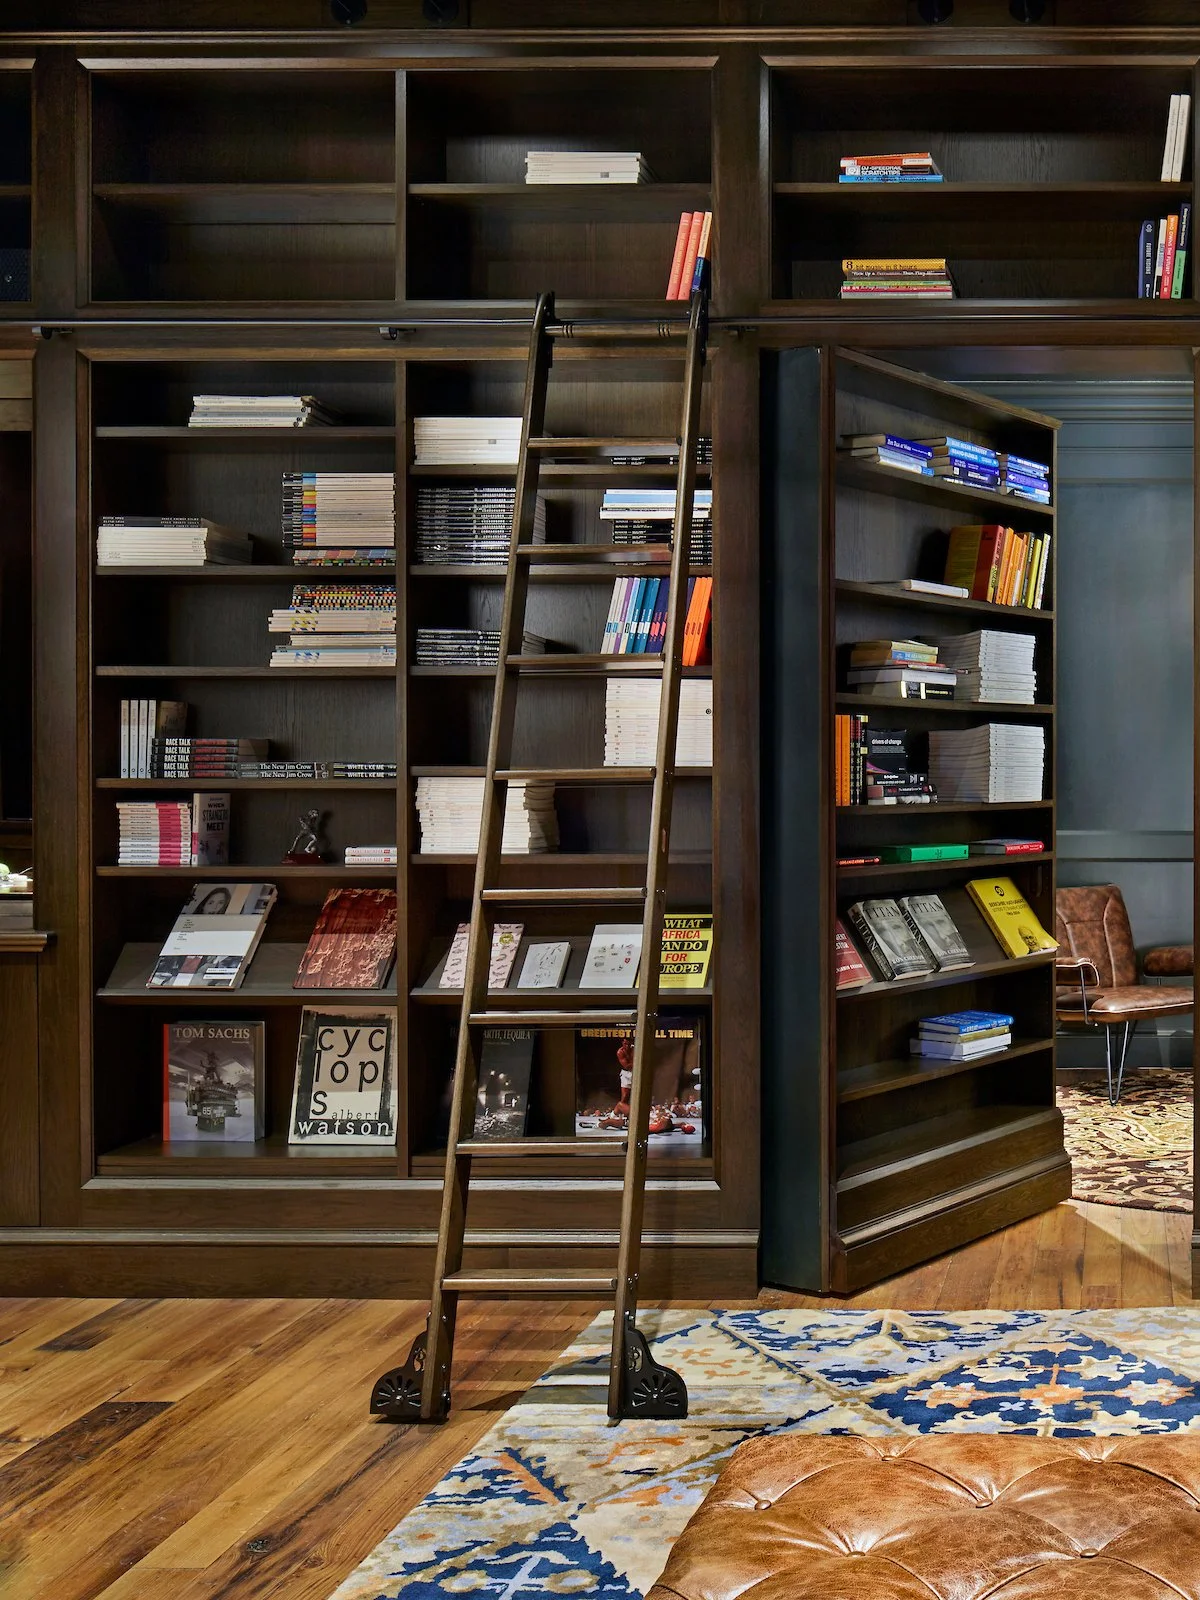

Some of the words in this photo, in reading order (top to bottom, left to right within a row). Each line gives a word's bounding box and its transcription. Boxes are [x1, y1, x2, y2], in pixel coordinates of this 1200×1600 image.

[166, 738, 178, 746] RACE
[178, 738, 191, 746] TALK
[165, 746, 178, 754] RACE
[178, 746, 190, 754] TALK
[164, 754, 176, 762] RACE
[178, 754, 190, 762] TALK
[164, 762, 176, 770] RACE
[177, 762, 189, 770] TALK
[286, 763, 295, 771] Jim
[164, 770, 176, 778] RACE
[177, 770, 190, 778] TALK
[286, 771, 296, 779] Jim
[202, 810, 229, 822] STRANGERS
[206, 822, 224, 831] MEET
[865, 906, 900, 919] TITAN
[908, 902, 944, 914] TITAN
[664, 919, 704, 928] WHAT
[904, 910, 924, 944] TITAN
[662, 930, 700, 939] AFRICA
[855, 916, 878, 951] TITAN
[661, 942, 681, 950] AN
[683, 941, 703, 950] DO
[665, 952, 688, 962] FOR
[660, 964, 699, 974] UROPE
[174, 1028, 204, 1038] TOM
[208, 1028, 250, 1038] SACHS
[502, 1030, 531, 1040] TEQUILA
[580, 1029, 632, 1038] GREATEST
[654, 1030, 668, 1038] LL
[668, 1030, 694, 1038] TIME
[202, 1107, 211, 1115] 65
[332, 1108, 378, 1120] albert
[298, 1120, 390, 1136] watson
